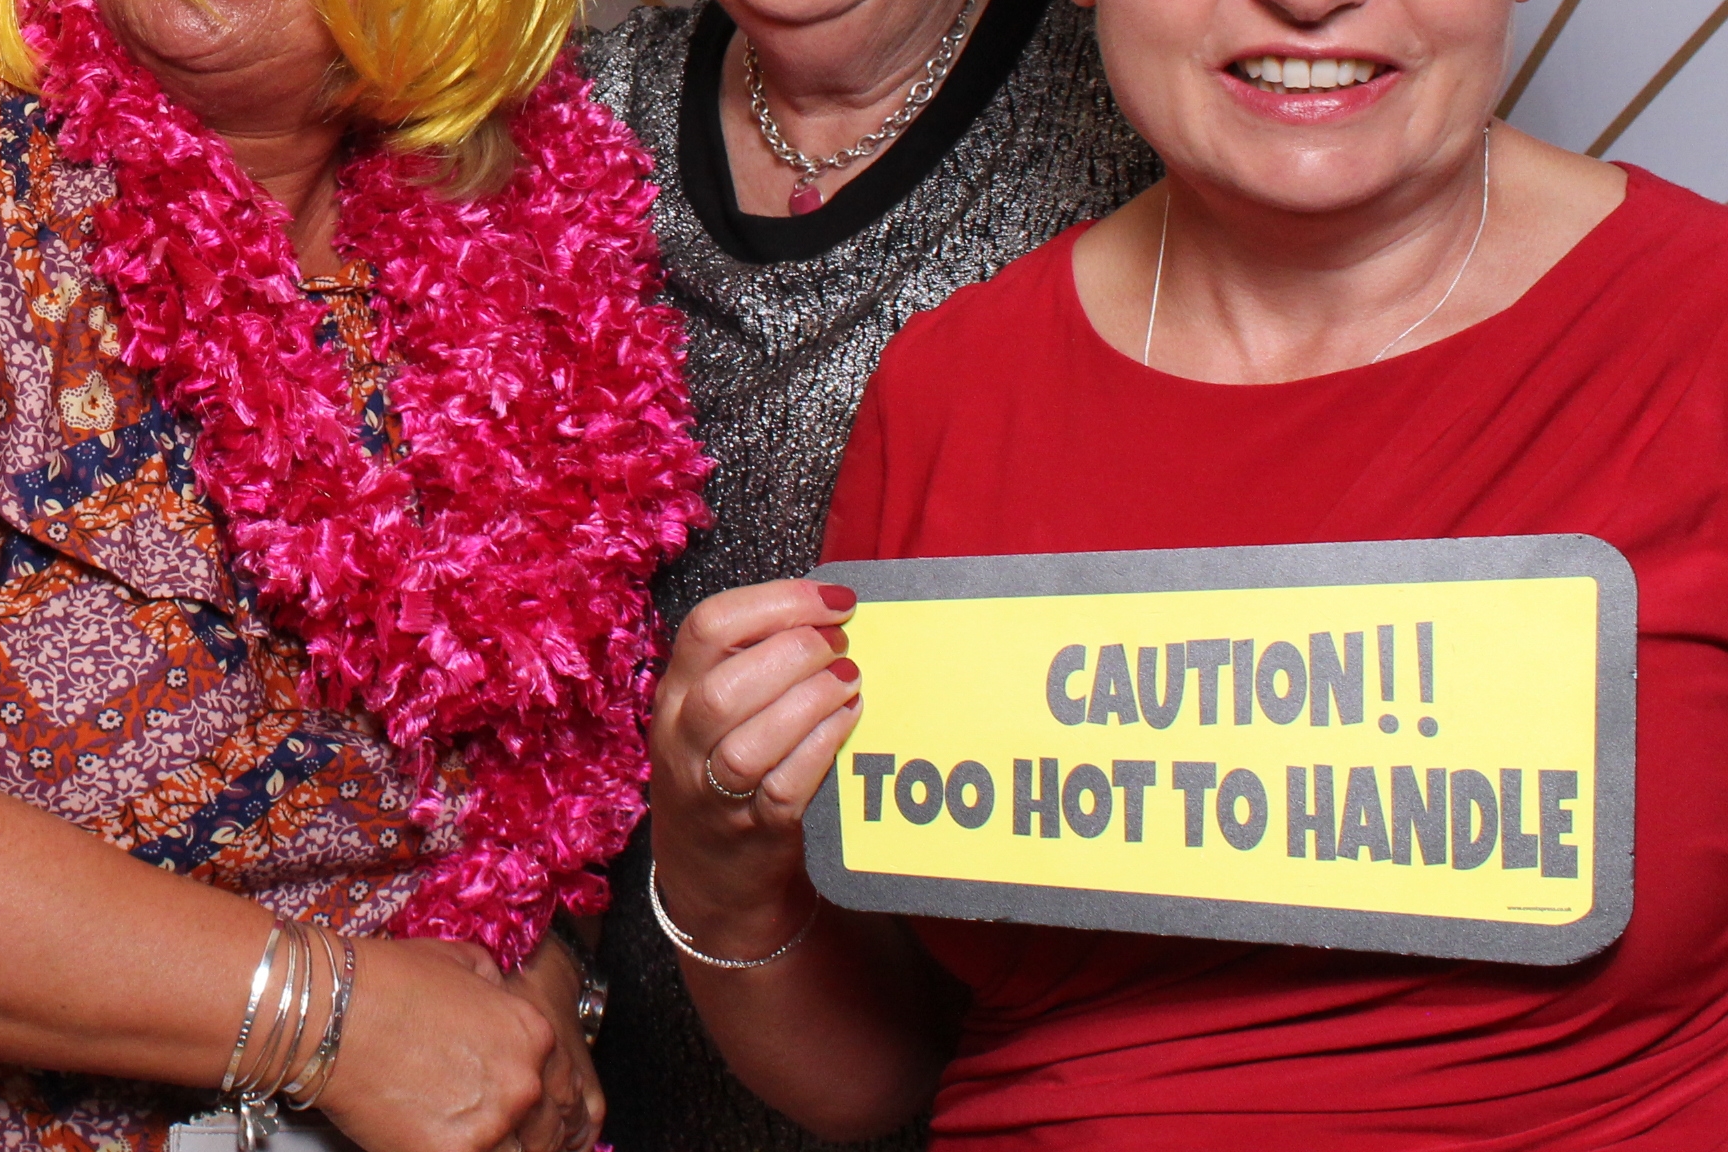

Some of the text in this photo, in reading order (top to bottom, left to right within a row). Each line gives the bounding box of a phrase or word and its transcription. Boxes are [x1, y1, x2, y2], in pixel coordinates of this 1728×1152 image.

[1046, 621, 1438, 737] CAUTION!!
[852, 753, 1578, 879] TOO HOT TO HANDLE
